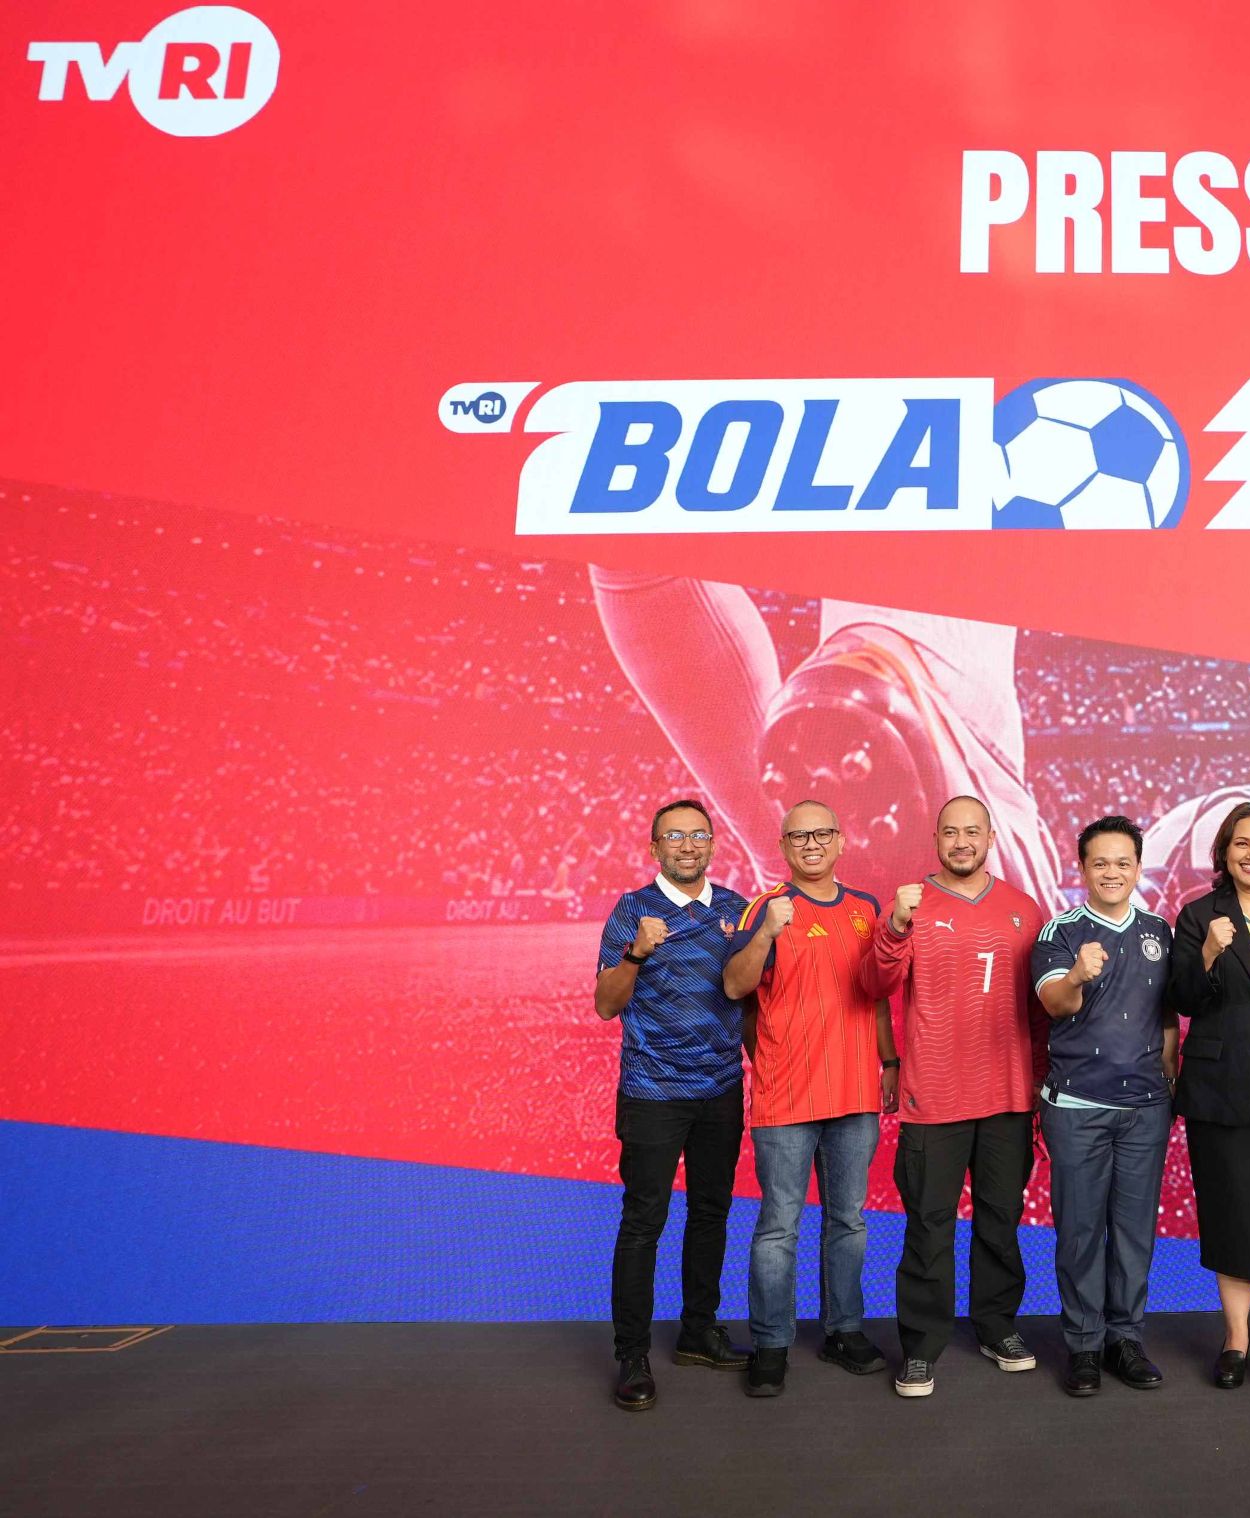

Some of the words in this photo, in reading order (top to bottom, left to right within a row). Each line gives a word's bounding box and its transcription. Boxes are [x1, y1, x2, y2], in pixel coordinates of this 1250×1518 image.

[27, 41, 253, 101] TVRI
[450, 400, 501, 415] TVRI
[568, 398, 961, 513] BOLA
[143, 898, 215, 925] DROIT
[219, 899, 252, 925] AU
[257, 899, 302, 924] BUT
[977, 952, 994, 993] 7
